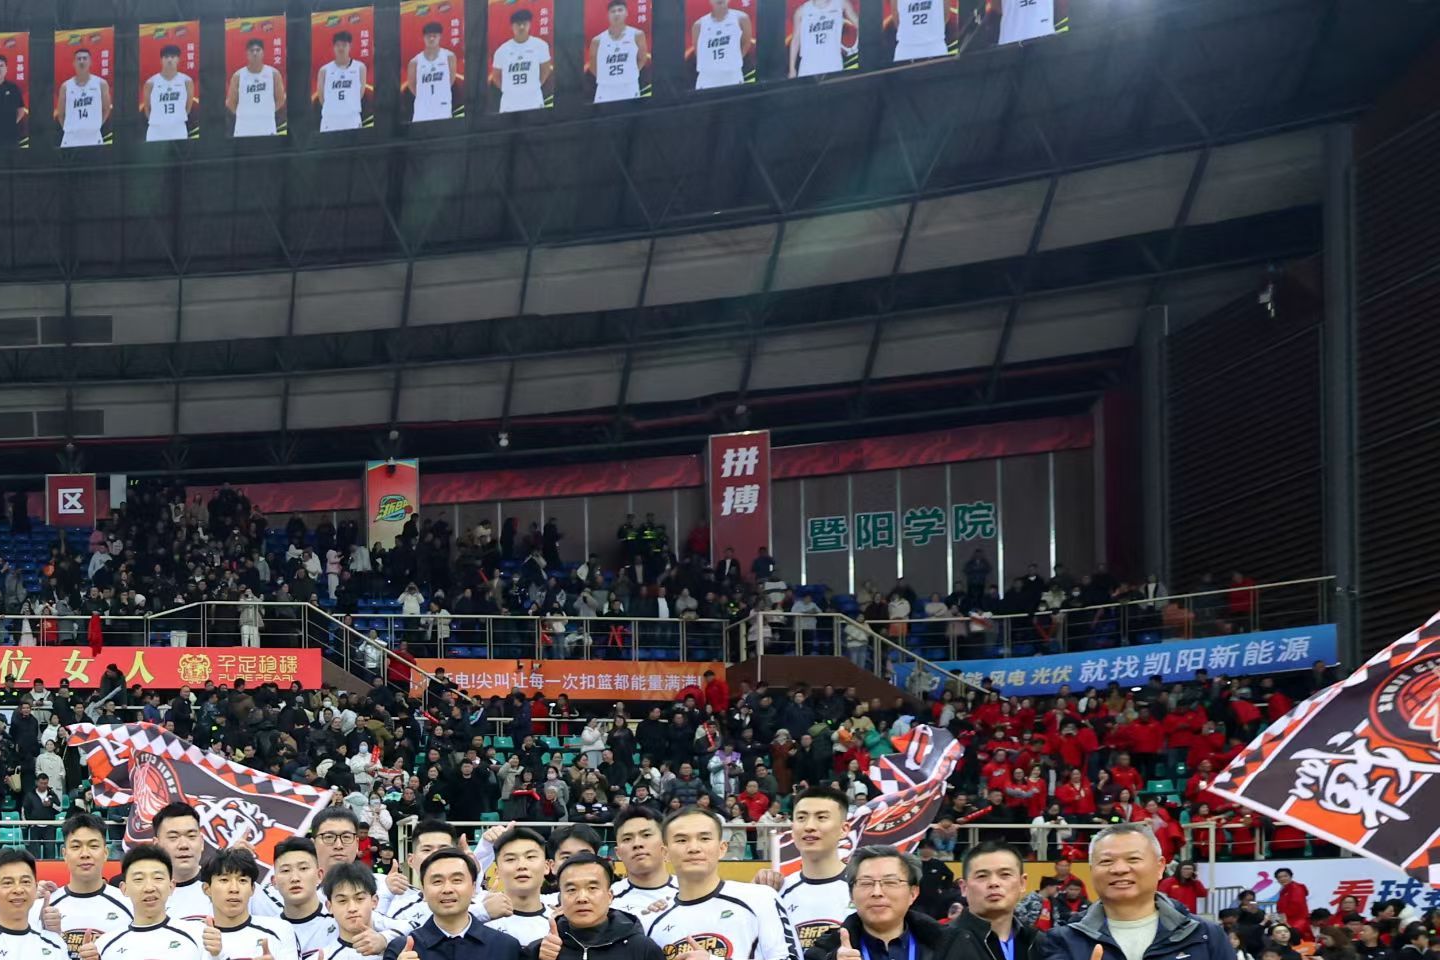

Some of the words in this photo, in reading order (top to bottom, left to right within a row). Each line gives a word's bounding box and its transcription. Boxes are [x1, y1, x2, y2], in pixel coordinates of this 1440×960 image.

[912, 13, 928, 25] 22
[815, 33, 827, 45] 12
[713, 48, 725, 60] 15
[608, 64, 623, 76] 25
[512, 73, 528, 85] 99
[430, 84, 435, 95] 1
[78, 109, 88, 119] 14
[163, 103, 175, 114] 13
[720, 446, 760, 516] 拼搏
[58, 488, 85, 514] 区
[807, 502, 997, 554] 暨阳学院
[989, 667, 1026, 687] 风电
[1030, 665, 1073, 686] 光伏
[1079, 635, 1310, 684] 就找凯阳新能源
[255, 675, 298, 683] PEARL
